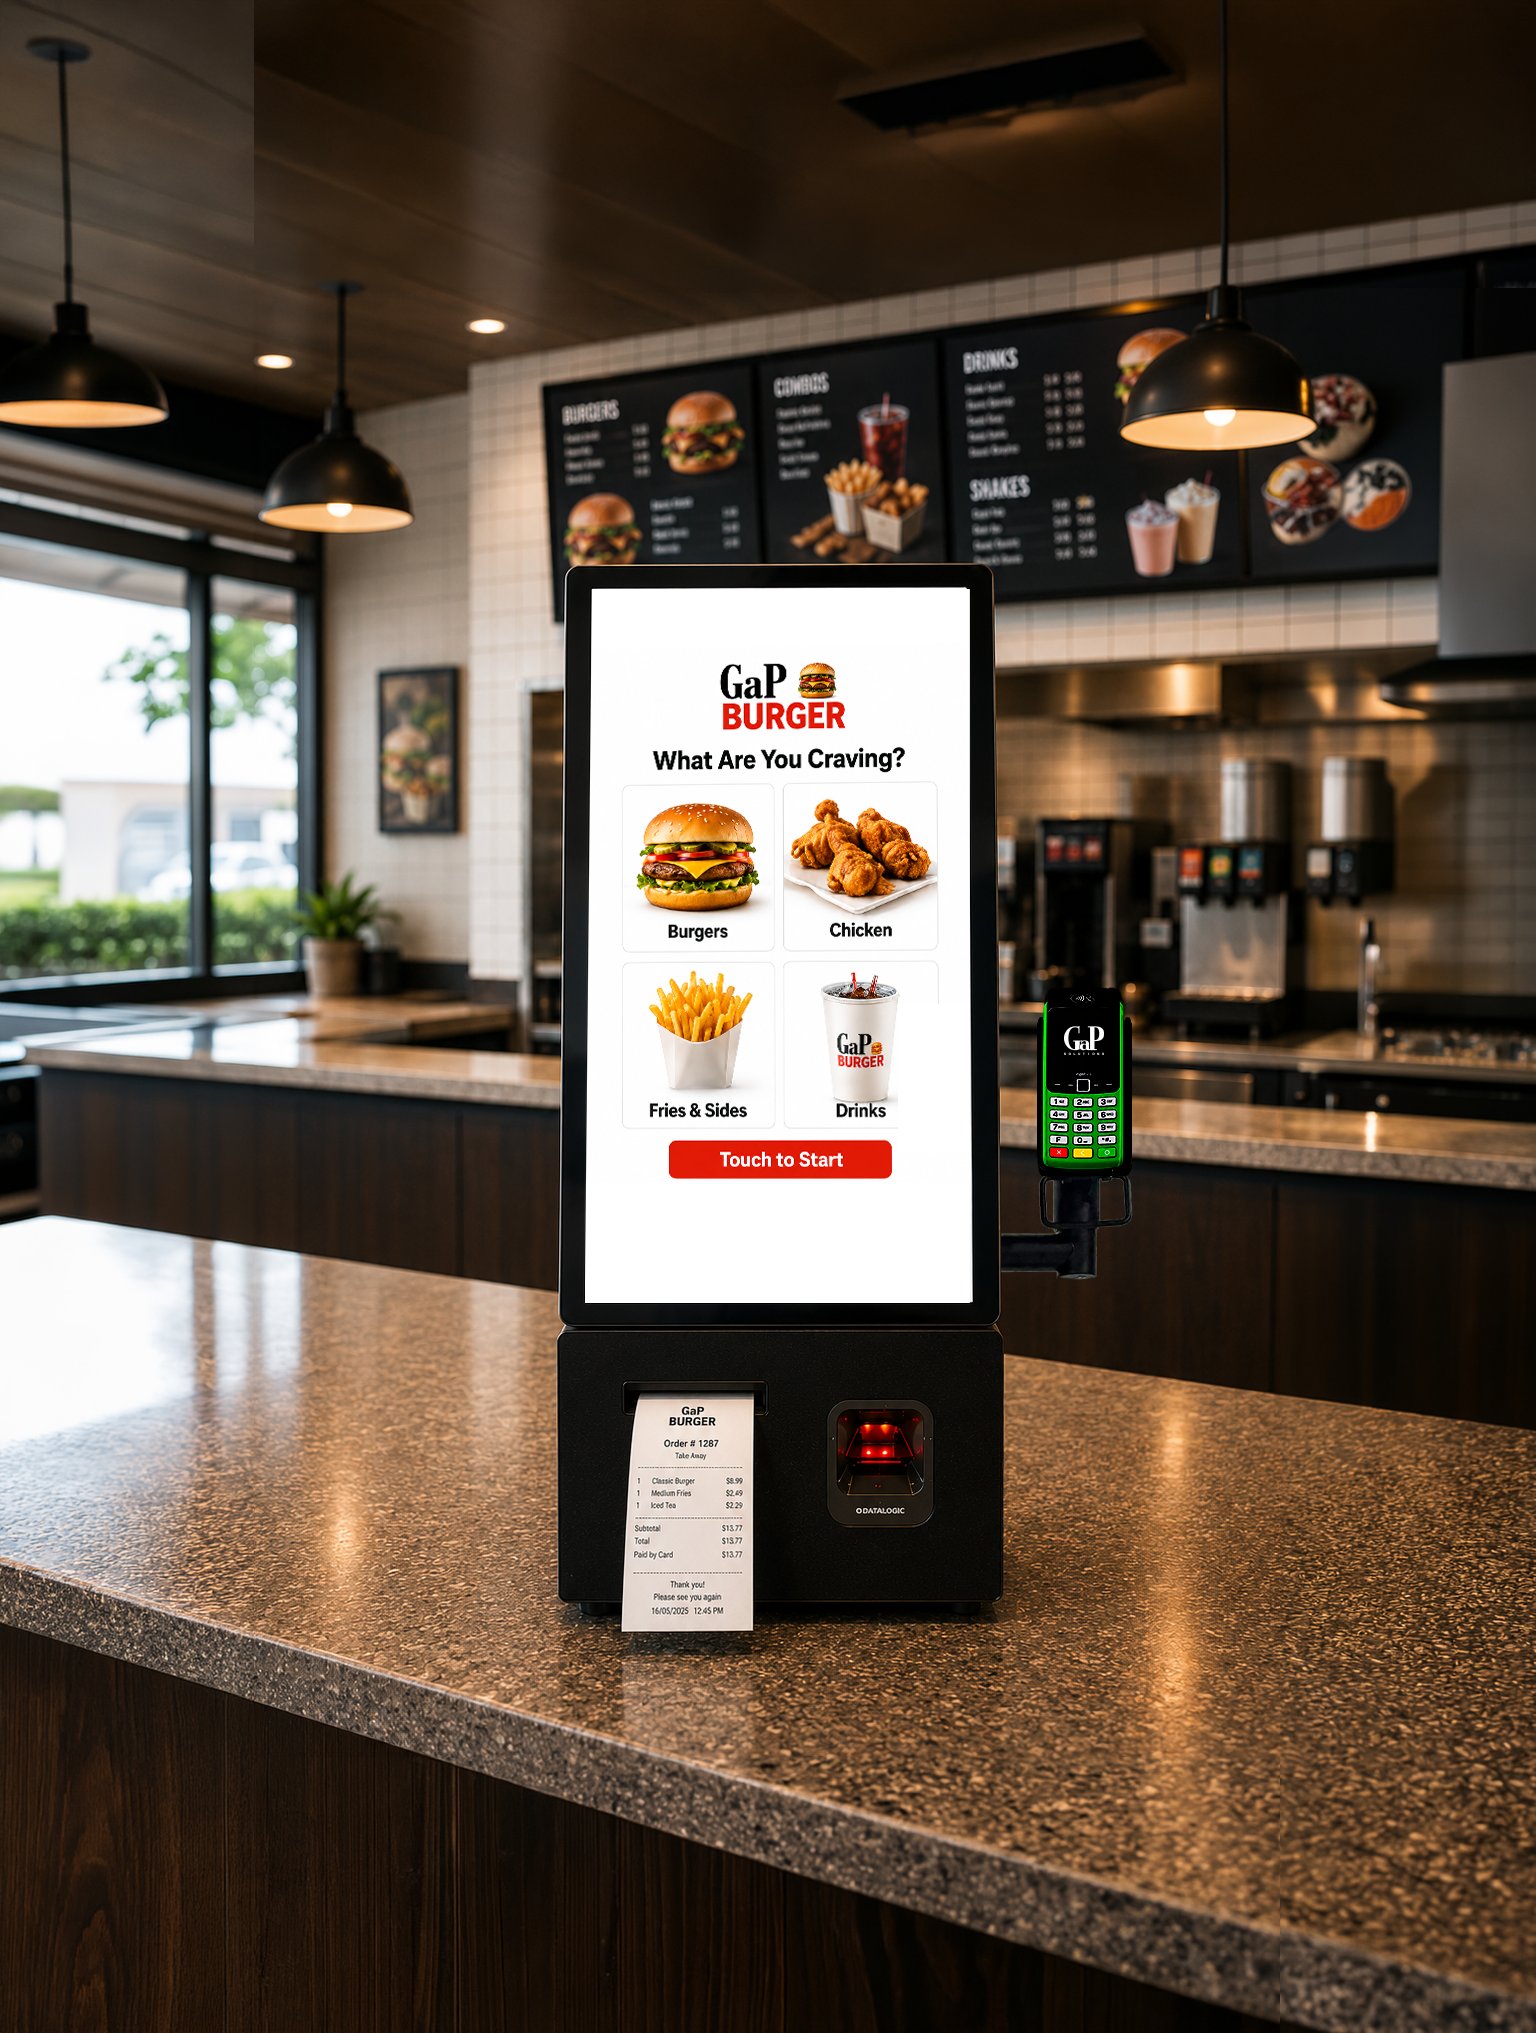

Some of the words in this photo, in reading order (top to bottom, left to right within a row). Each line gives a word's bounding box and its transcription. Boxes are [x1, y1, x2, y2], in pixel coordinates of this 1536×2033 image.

[963, 347, 1019, 374] DRINKS
[773, 372, 830, 398] COMBOS
[562, 399, 620, 426] BURGERS
[969, 475, 1031, 502] SHAKES
[720, 663, 787, 699] GaP
[722, 702, 846, 730] BURGER
[653, 750, 713, 770] What
[718, 750, 756, 770] Are
[761, 749, 802, 769] You
[808, 747, 906, 772] Craving?
[668, 924, 728, 942] Burgers
[829, 923, 893, 938] Chicken
[836, 1033, 872, 1055] GaP
[1063, 1025, 1105, 1051] GaP
[837, 1055, 884, 1068] BURGER
[649, 1103, 686, 1118] Fries
[690, 1103, 701, 1118] &
[705, 1103, 748, 1118] Sides
[835, 1103, 887, 1118] Drinks
[720, 1151, 772, 1168] Touch
[776, 1153, 795, 1168] to
[798, 1151, 844, 1168] Start
[681, 1406, 705, 1415] GaP
[668, 1417, 716, 1426] BURGER
[663, 1439, 688, 1448] Order
[690, 1439, 696, 1447] #
[698, 1439, 719, 1448] 1287
[690, 1452, 707, 1461] Away
[652, 1477, 674, 1485] Classic
[675, 1477, 695, 1486] Burger
[725, 1477, 743, 1485] $8.99
[650, 1489, 676, 1497] Medium
[676, 1489, 692, 1497] Fries
[725, 1489, 743, 1497] $2.49
[650, 1501, 664, 1509] Iced
[665, 1501, 676, 1509] Tea
[725, 1501, 743, 1509] $2.29
[634, 1537, 650, 1545] Total
[721, 1537, 743, 1545] $13.77
[633, 1551, 648, 1559] Paid
[648, 1551, 657, 1560] by
[658, 1551, 674, 1559] Card
[721, 1551, 743, 1559] $13.77
[670, 1580, 690, 1588] Thank
[691, 1581, 705, 1590] you!
[653, 1593, 675, 1601] Please
[703, 1593, 722, 1602] again
[651, 1607, 689, 1615] 16/05/2025
